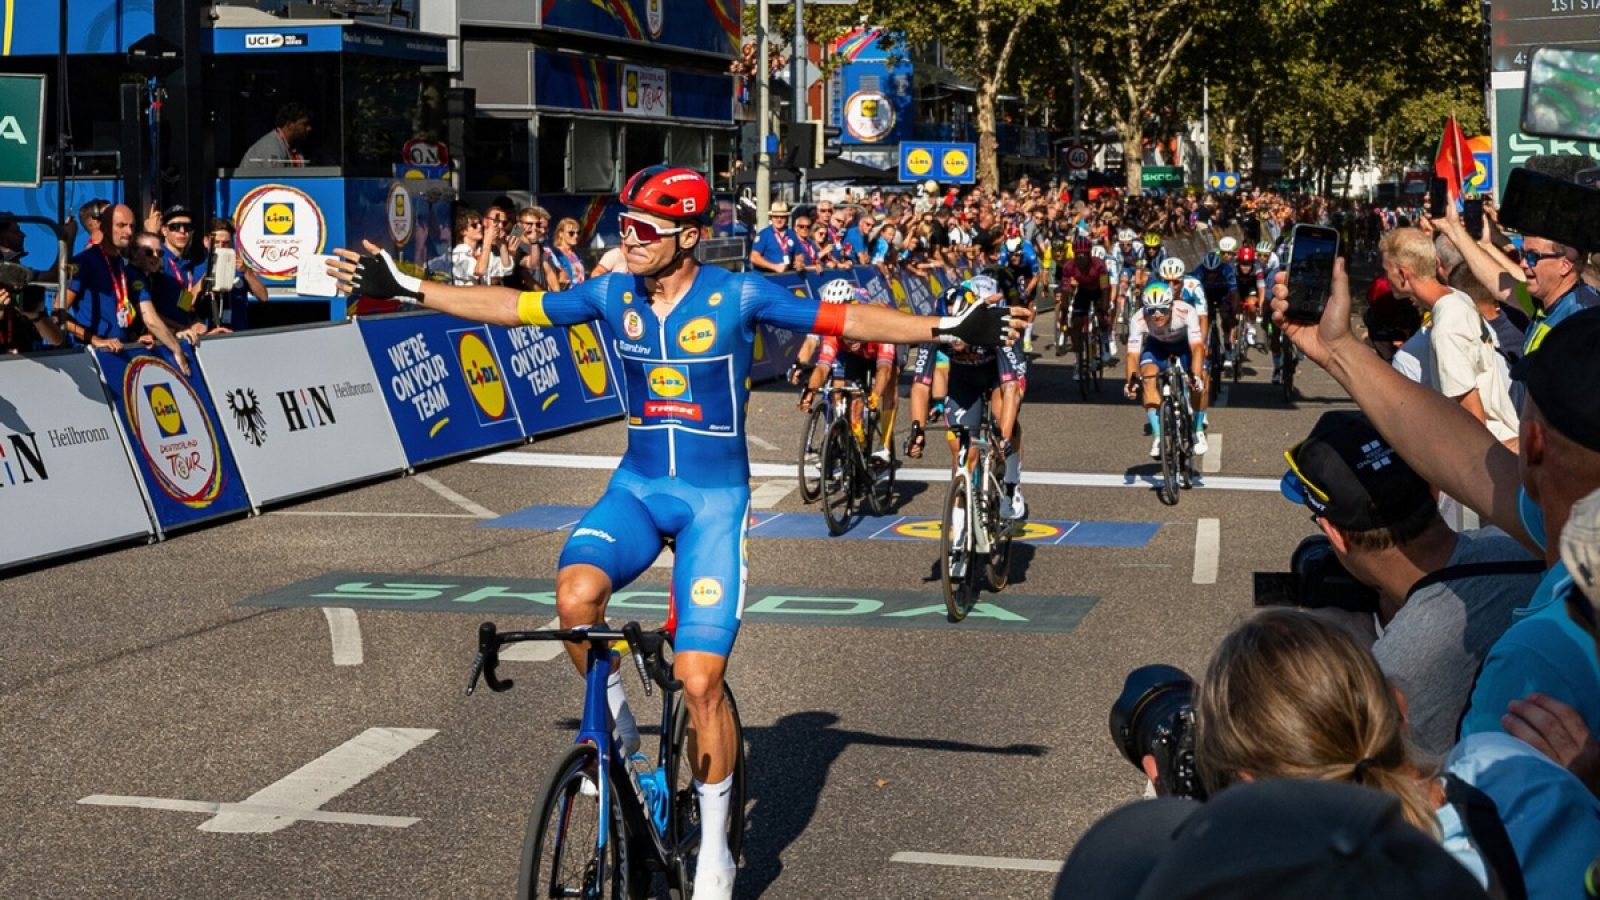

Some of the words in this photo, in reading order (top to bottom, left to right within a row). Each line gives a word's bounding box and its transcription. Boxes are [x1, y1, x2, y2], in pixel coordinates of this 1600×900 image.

[248, 36, 269, 46] UCI
[388, 332, 430, 371] WE'RE
[511, 350, 531, 378] ON
[526, 336, 560, 368] YOUR
[333, 382, 374, 399] Heilbronn
[392, 370, 416, 402] ON
[411, 354, 449, 391] YOUR
[528, 361, 560, 396] TEAM
[412, 383, 450, 421] TEAM
[48, 426, 110, 448] Heilbronn
